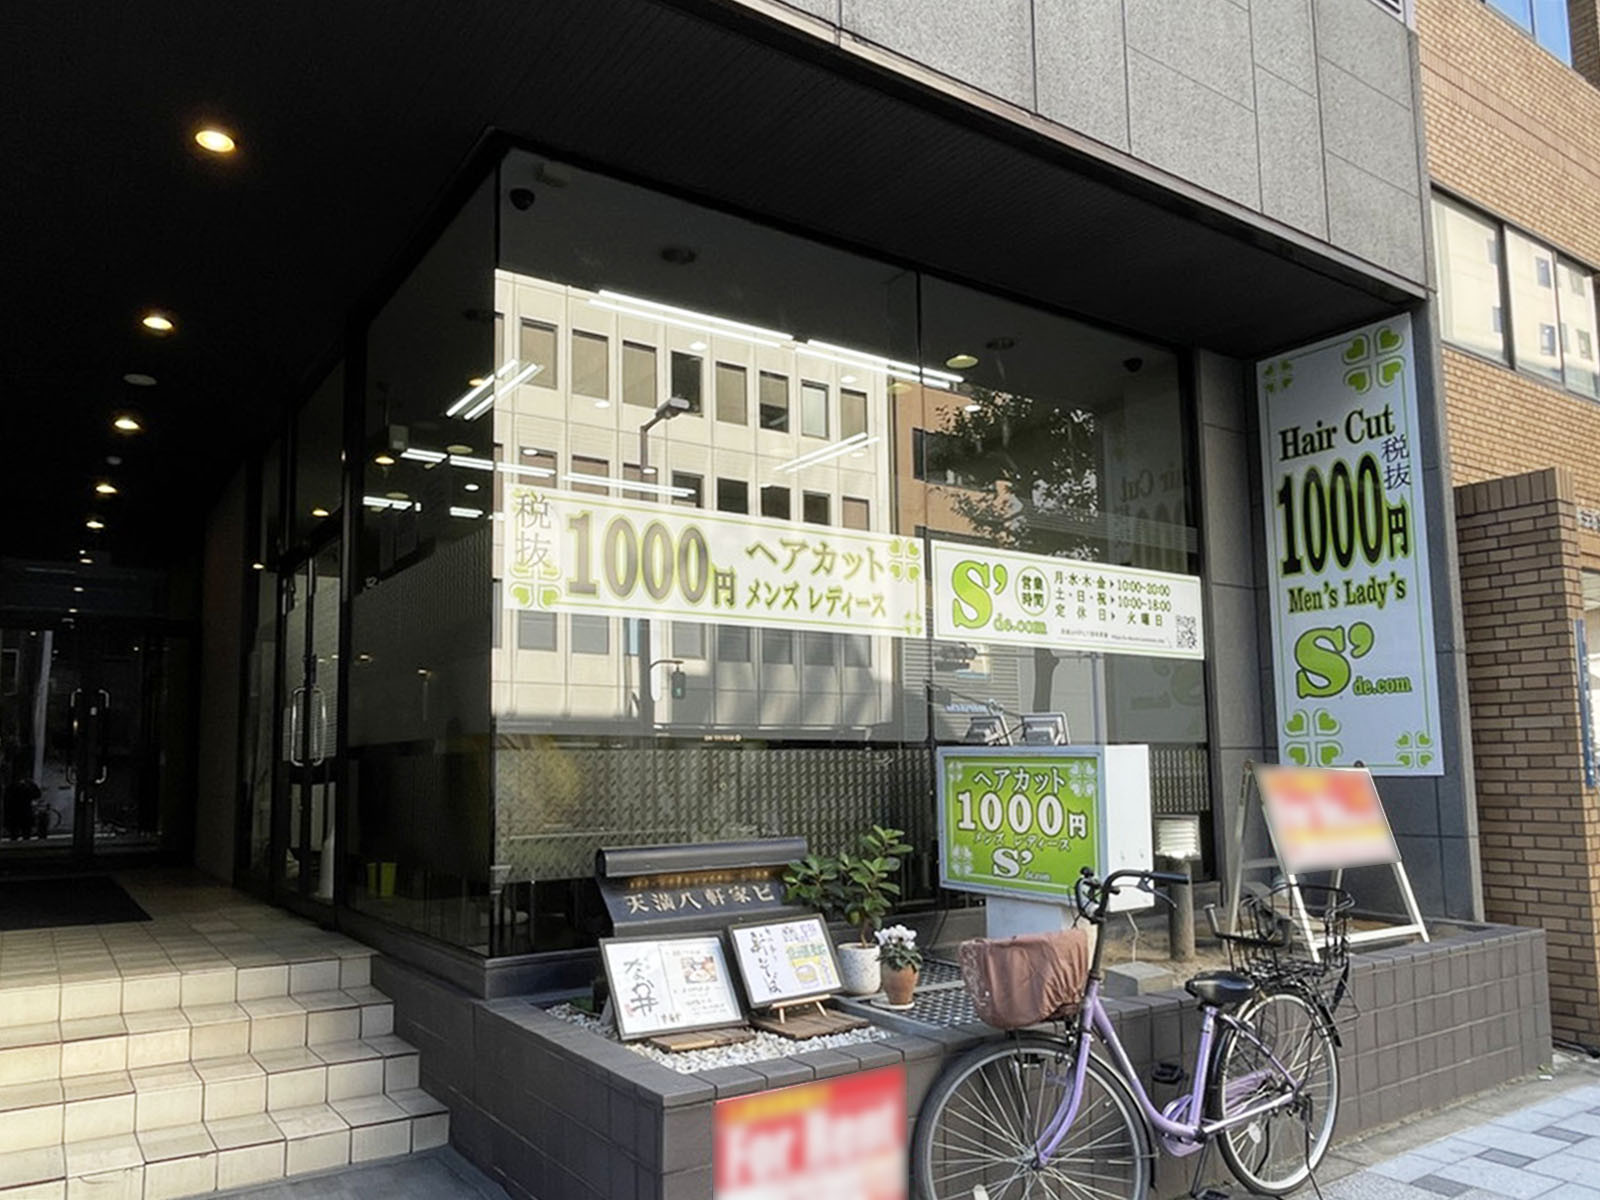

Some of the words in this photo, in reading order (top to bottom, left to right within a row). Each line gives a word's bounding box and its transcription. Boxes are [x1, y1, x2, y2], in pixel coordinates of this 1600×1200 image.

[1278, 420, 1337, 461] Hair
[1345, 404, 1395, 444] Cut
[1382, 435, 1411, 490] 税抜
[515, 491, 552, 568] 税抜
[1278, 454, 1409, 574] 1000円
[565, 509, 736, 607] 1000円
[746, 537, 884, 582] ヘアカット
[745, 579, 800, 610] メンズ
[808, 585, 887, 618] レディース
[1287, 581, 1338, 614] Men's
[1345, 571, 1407, 610] Lady's
[1352, 675, 1412, 696] de.com
[974, 767, 1066, 794] ヘアカット
[957, 791, 1088, 839] 1000円
[624, 883, 785, 914] 天満八軒家ビ
